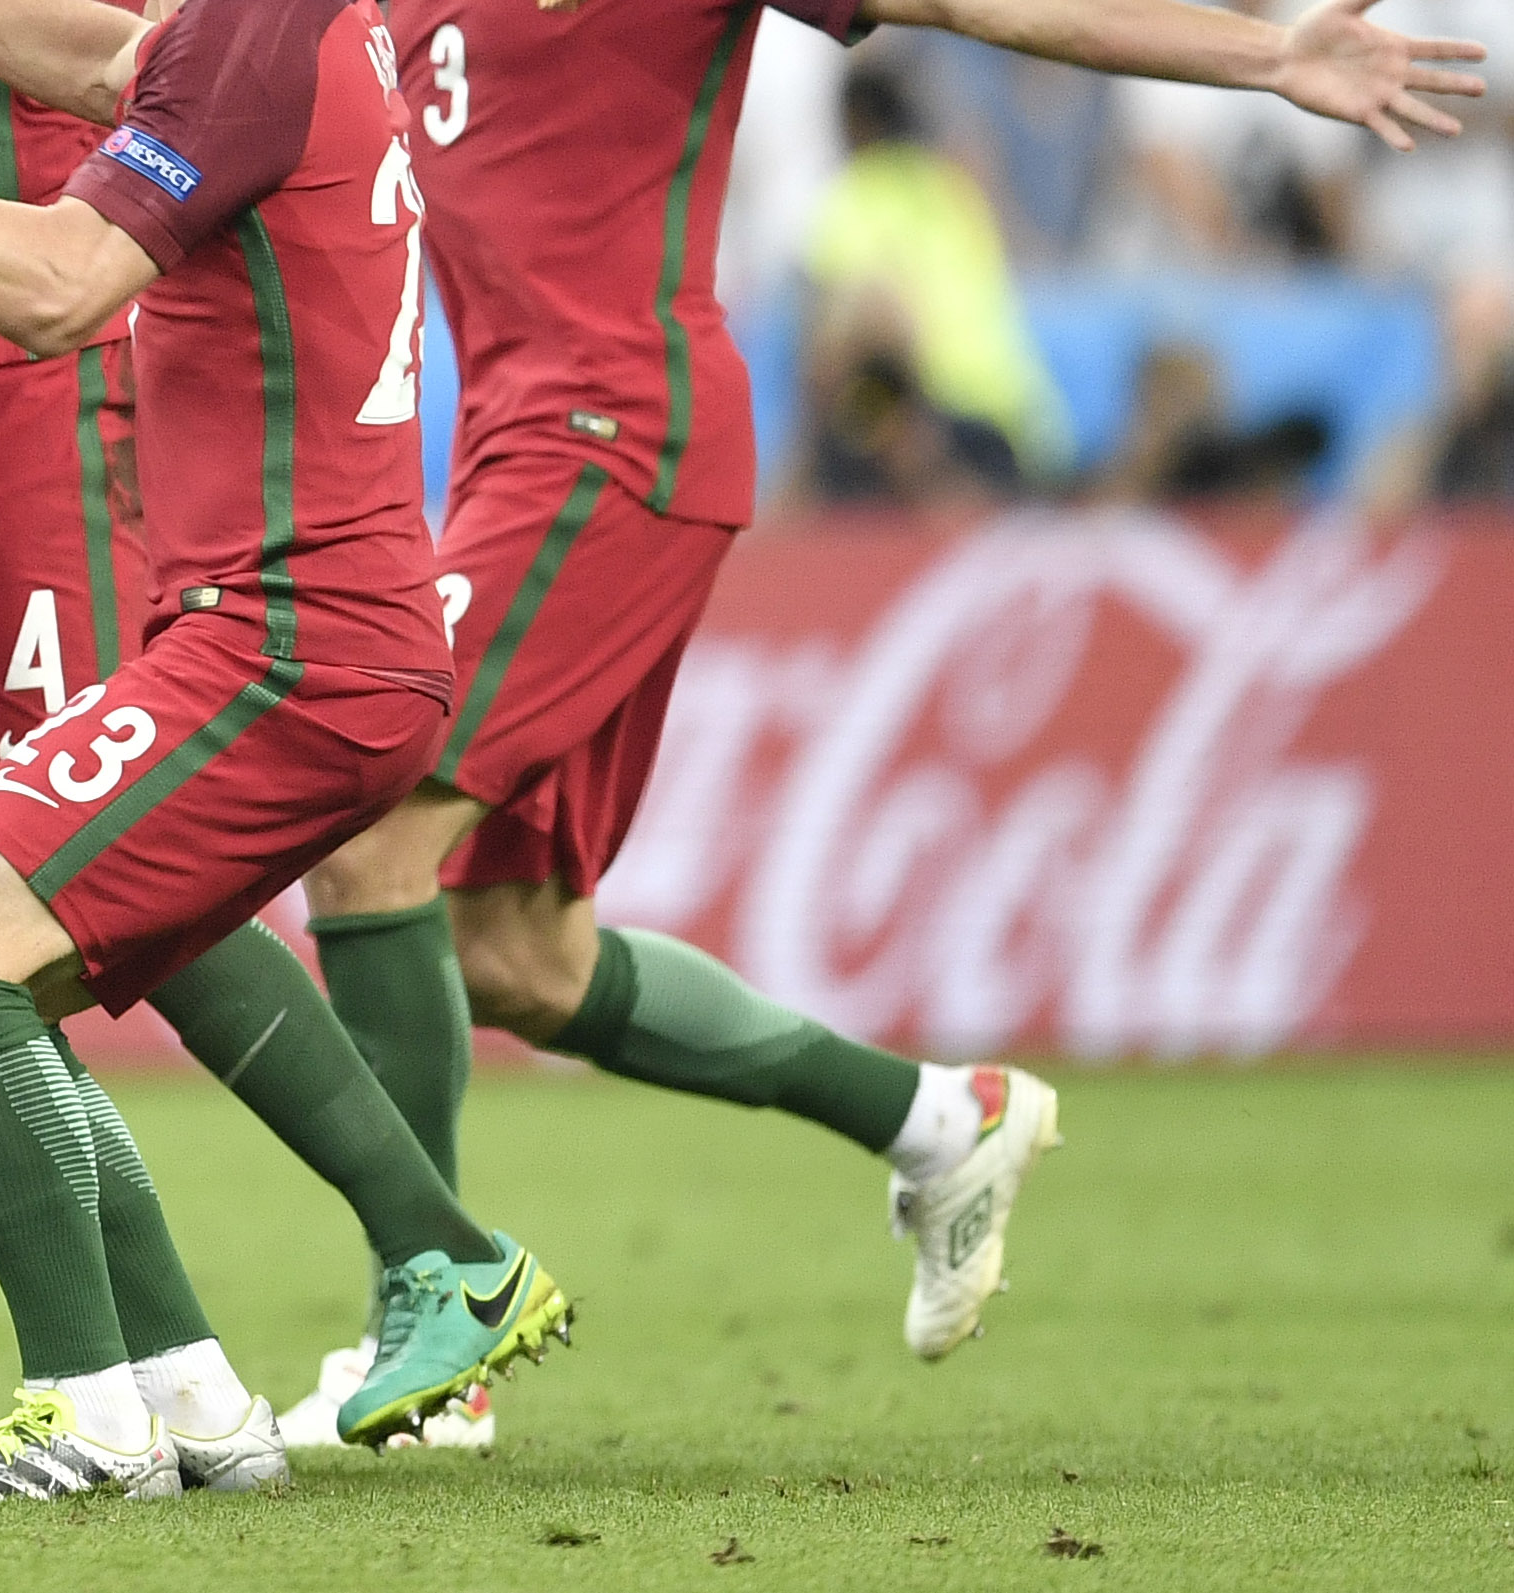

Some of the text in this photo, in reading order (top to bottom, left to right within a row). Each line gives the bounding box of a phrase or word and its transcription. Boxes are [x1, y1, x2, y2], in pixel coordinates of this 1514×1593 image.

[422, 22, 470, 147] 3
[122, 139, 198, 193] RESPECT
[3, 588, 67, 714] 4
[6, 683, 158, 804] 23
